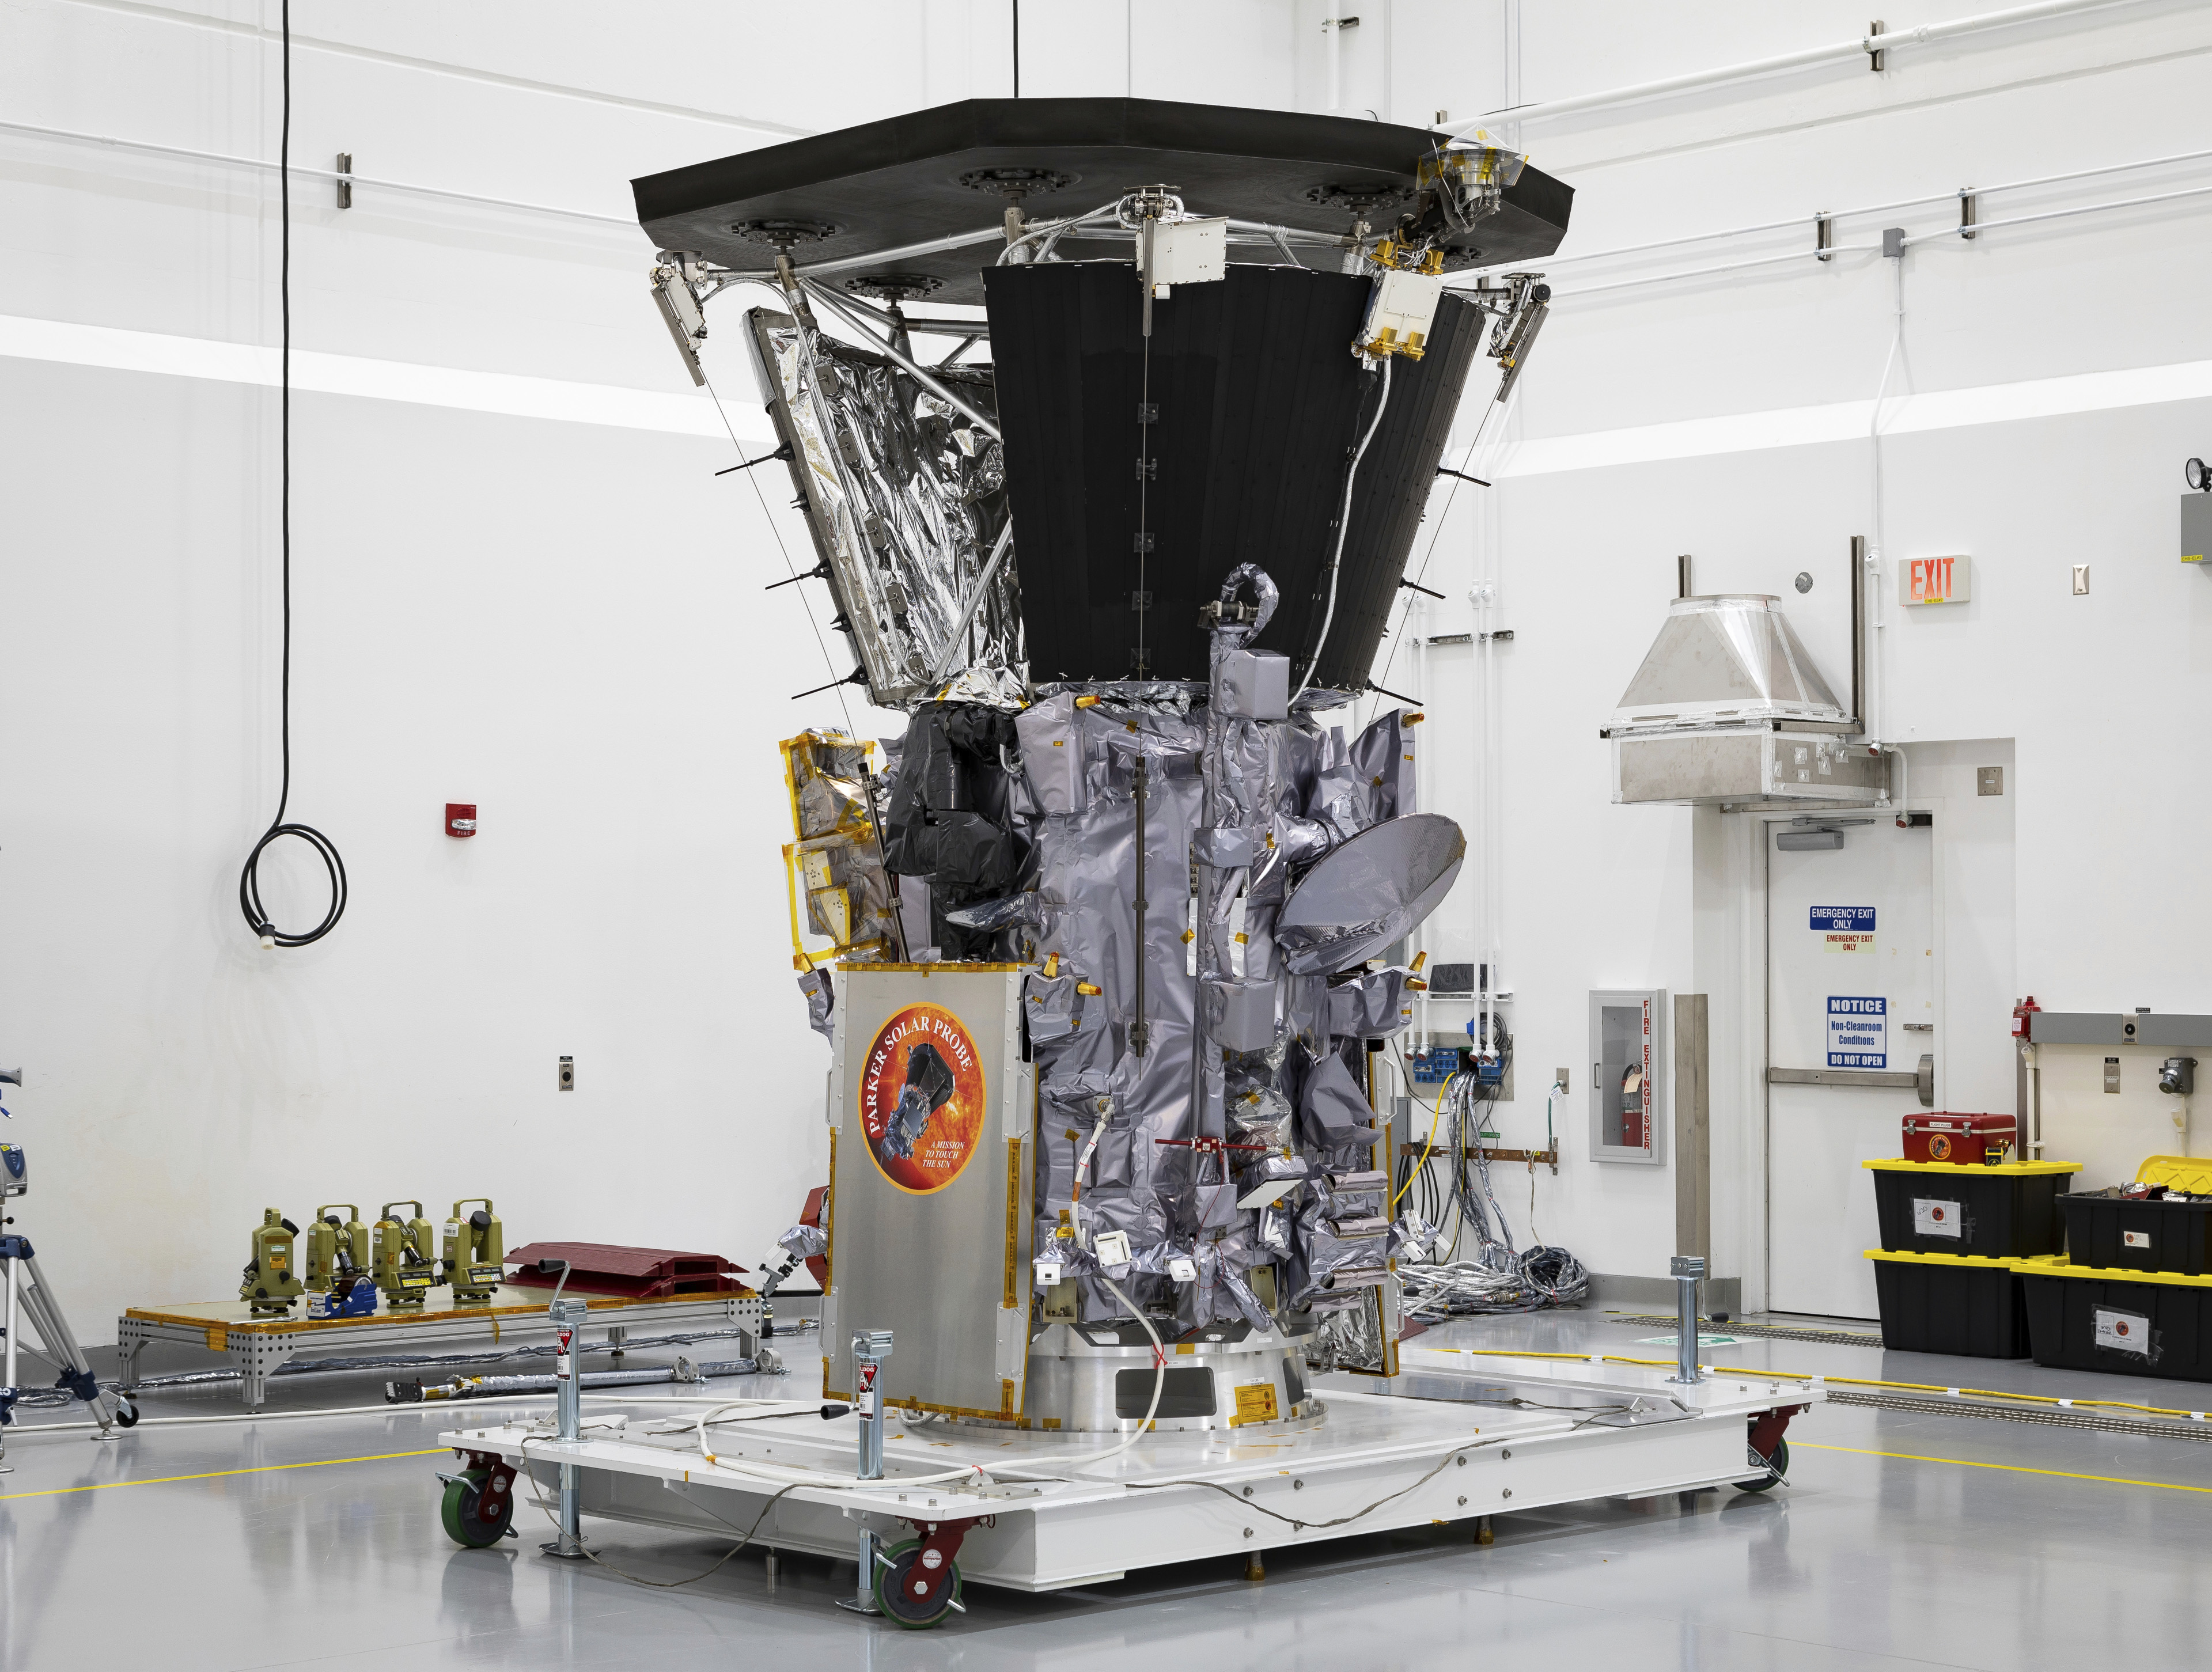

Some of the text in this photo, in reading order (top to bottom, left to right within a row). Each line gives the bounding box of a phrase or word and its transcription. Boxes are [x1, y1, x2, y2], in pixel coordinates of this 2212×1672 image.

[1911, 558, 1955, 600] EXIT
[1812, 908, 1874, 919] EMERGENCY EXIT
[1833, 919, 1852, 929] ONLY
[1831, 999, 1883, 1013] NOTICE
[1831, 1021, 1883, 1032] Non-Cleanroom
[1839, 1034, 1875, 1046] Conditions
[1831, 1055, 1883, 1066] DO NOT OPEN
[867, 1016, 972, 1135] PARKER SOLAR PROBE
[937, 1141, 965, 1150] MISSION
[935, 1150, 959, 1159] TOUCH
[922, 1159, 951, 1169] THE SUN
